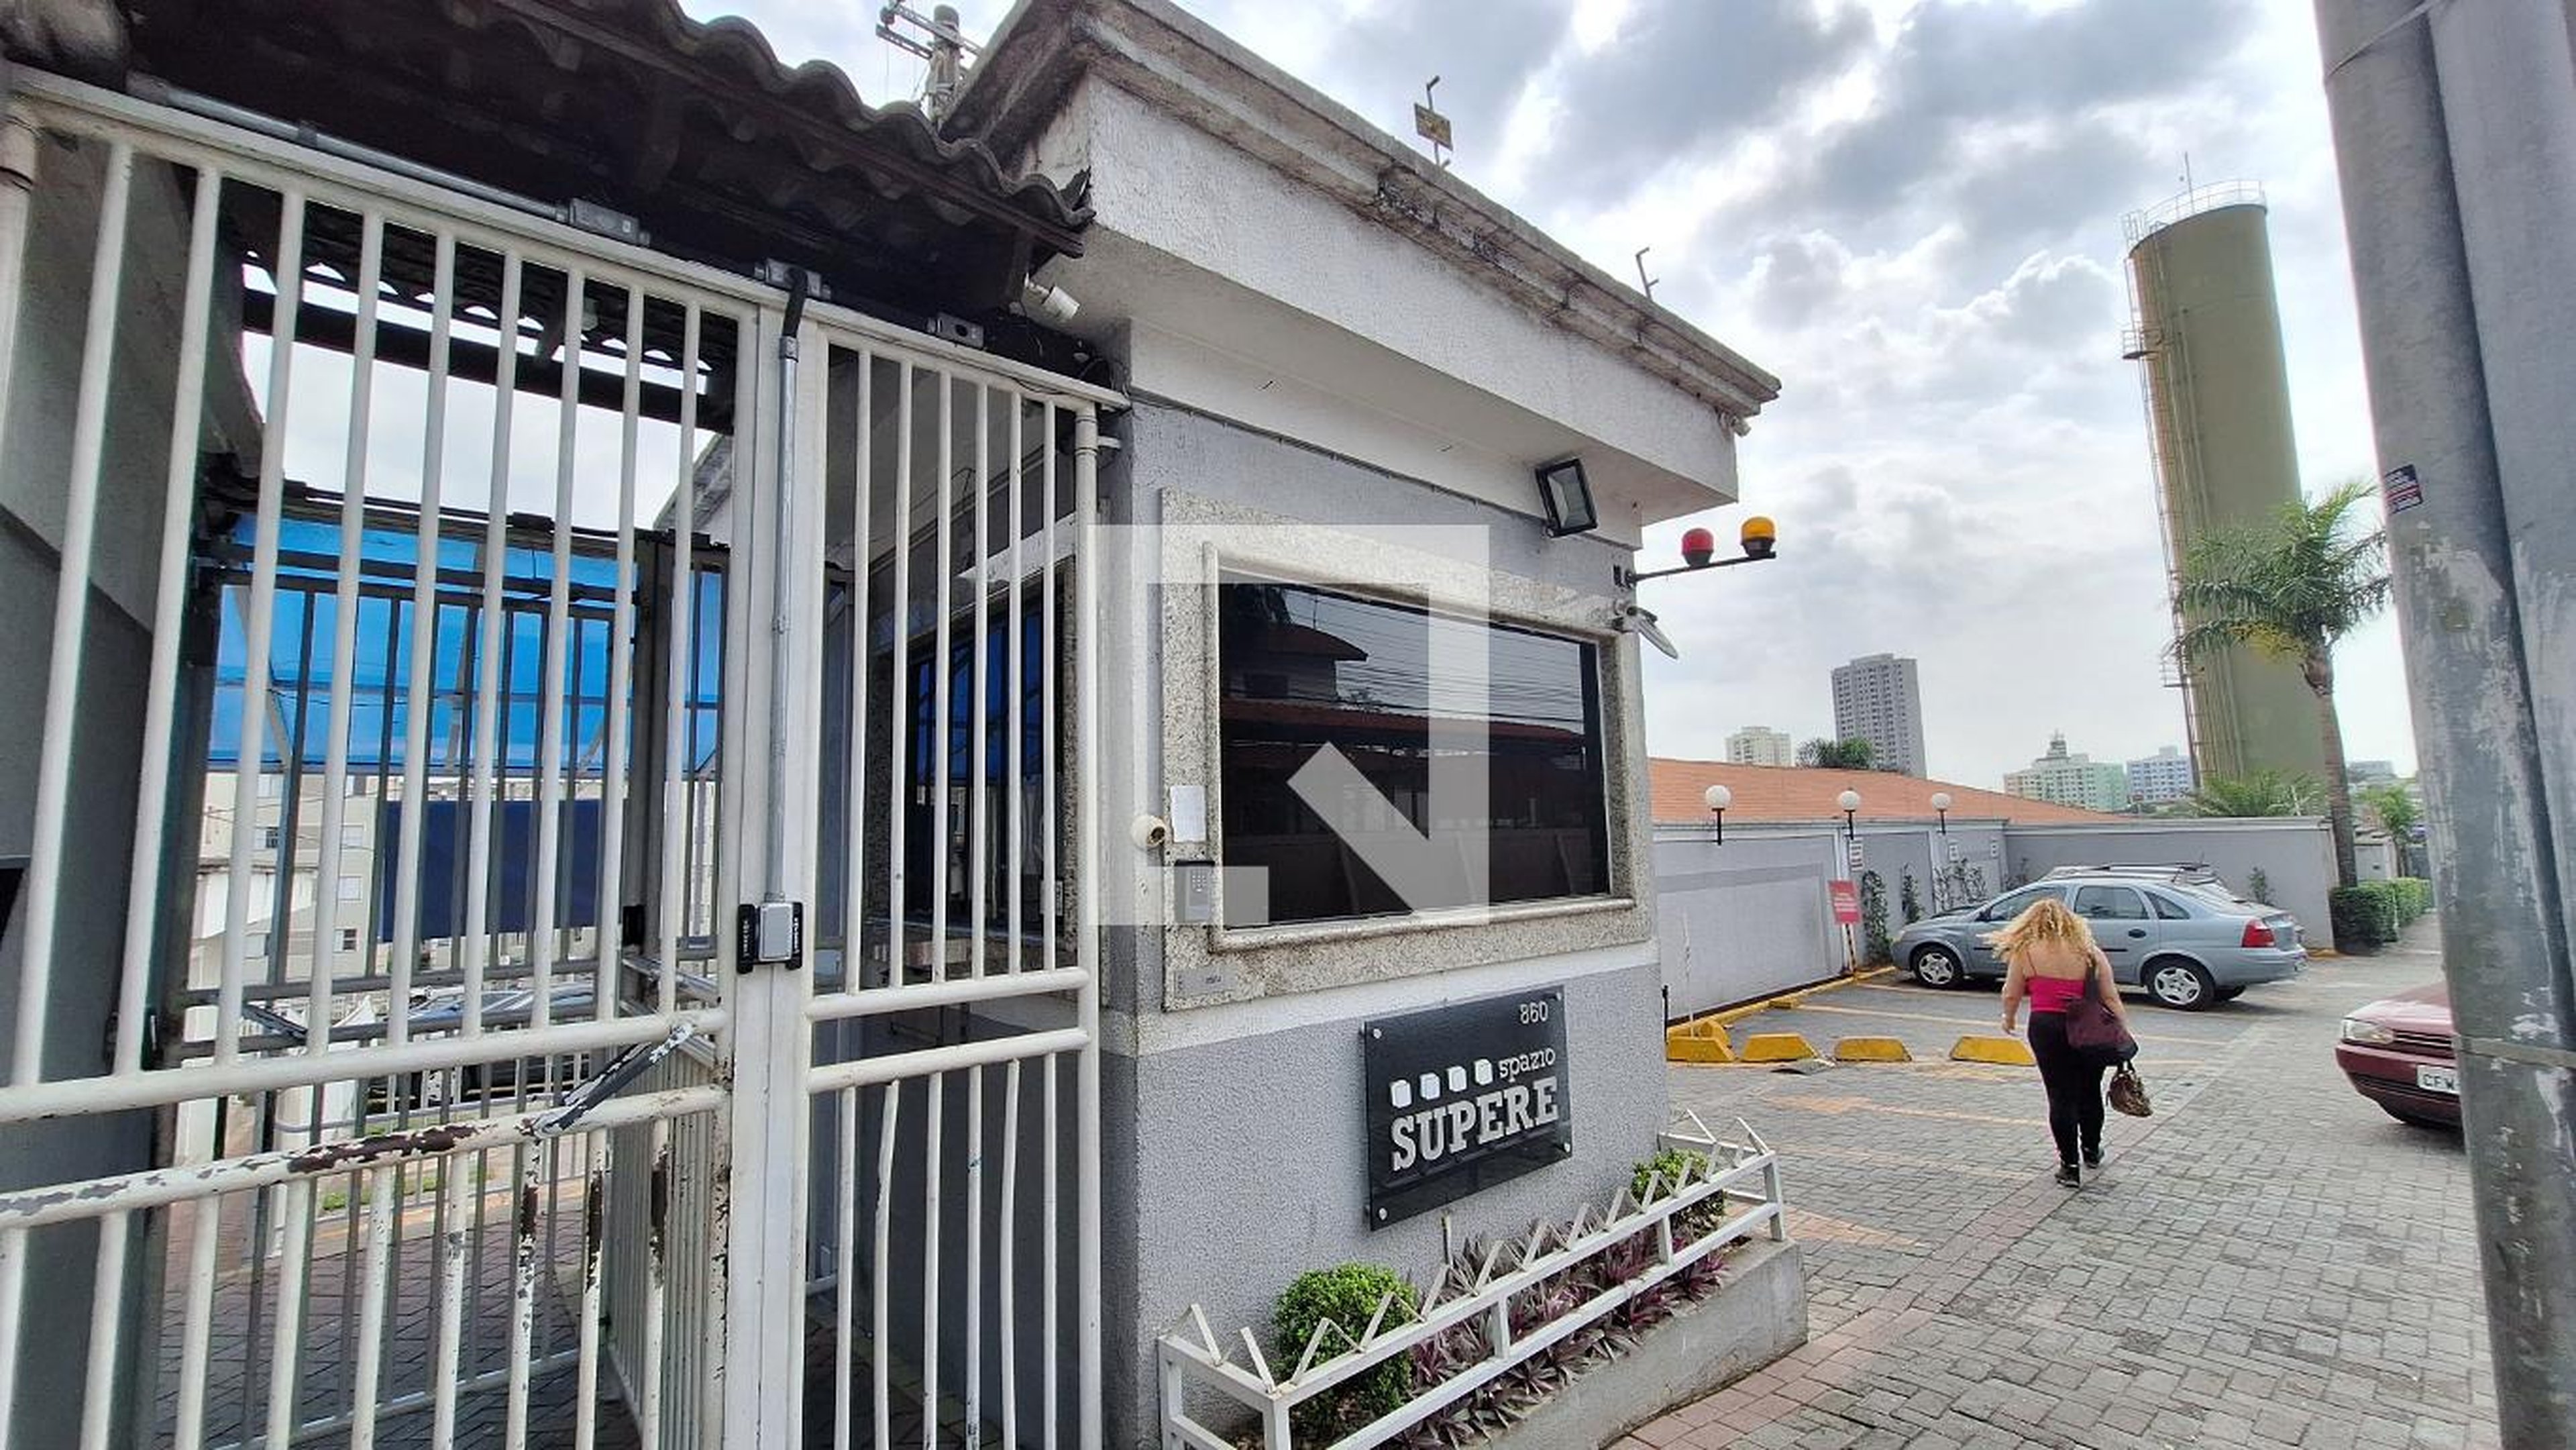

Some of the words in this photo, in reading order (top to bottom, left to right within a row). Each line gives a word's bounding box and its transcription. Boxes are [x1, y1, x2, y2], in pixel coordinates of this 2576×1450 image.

[1519, 1000, 1548, 1024] 860
[1499, 1047, 1556, 1083] spazio
[1391, 1076, 1559, 1172] SUPERE
